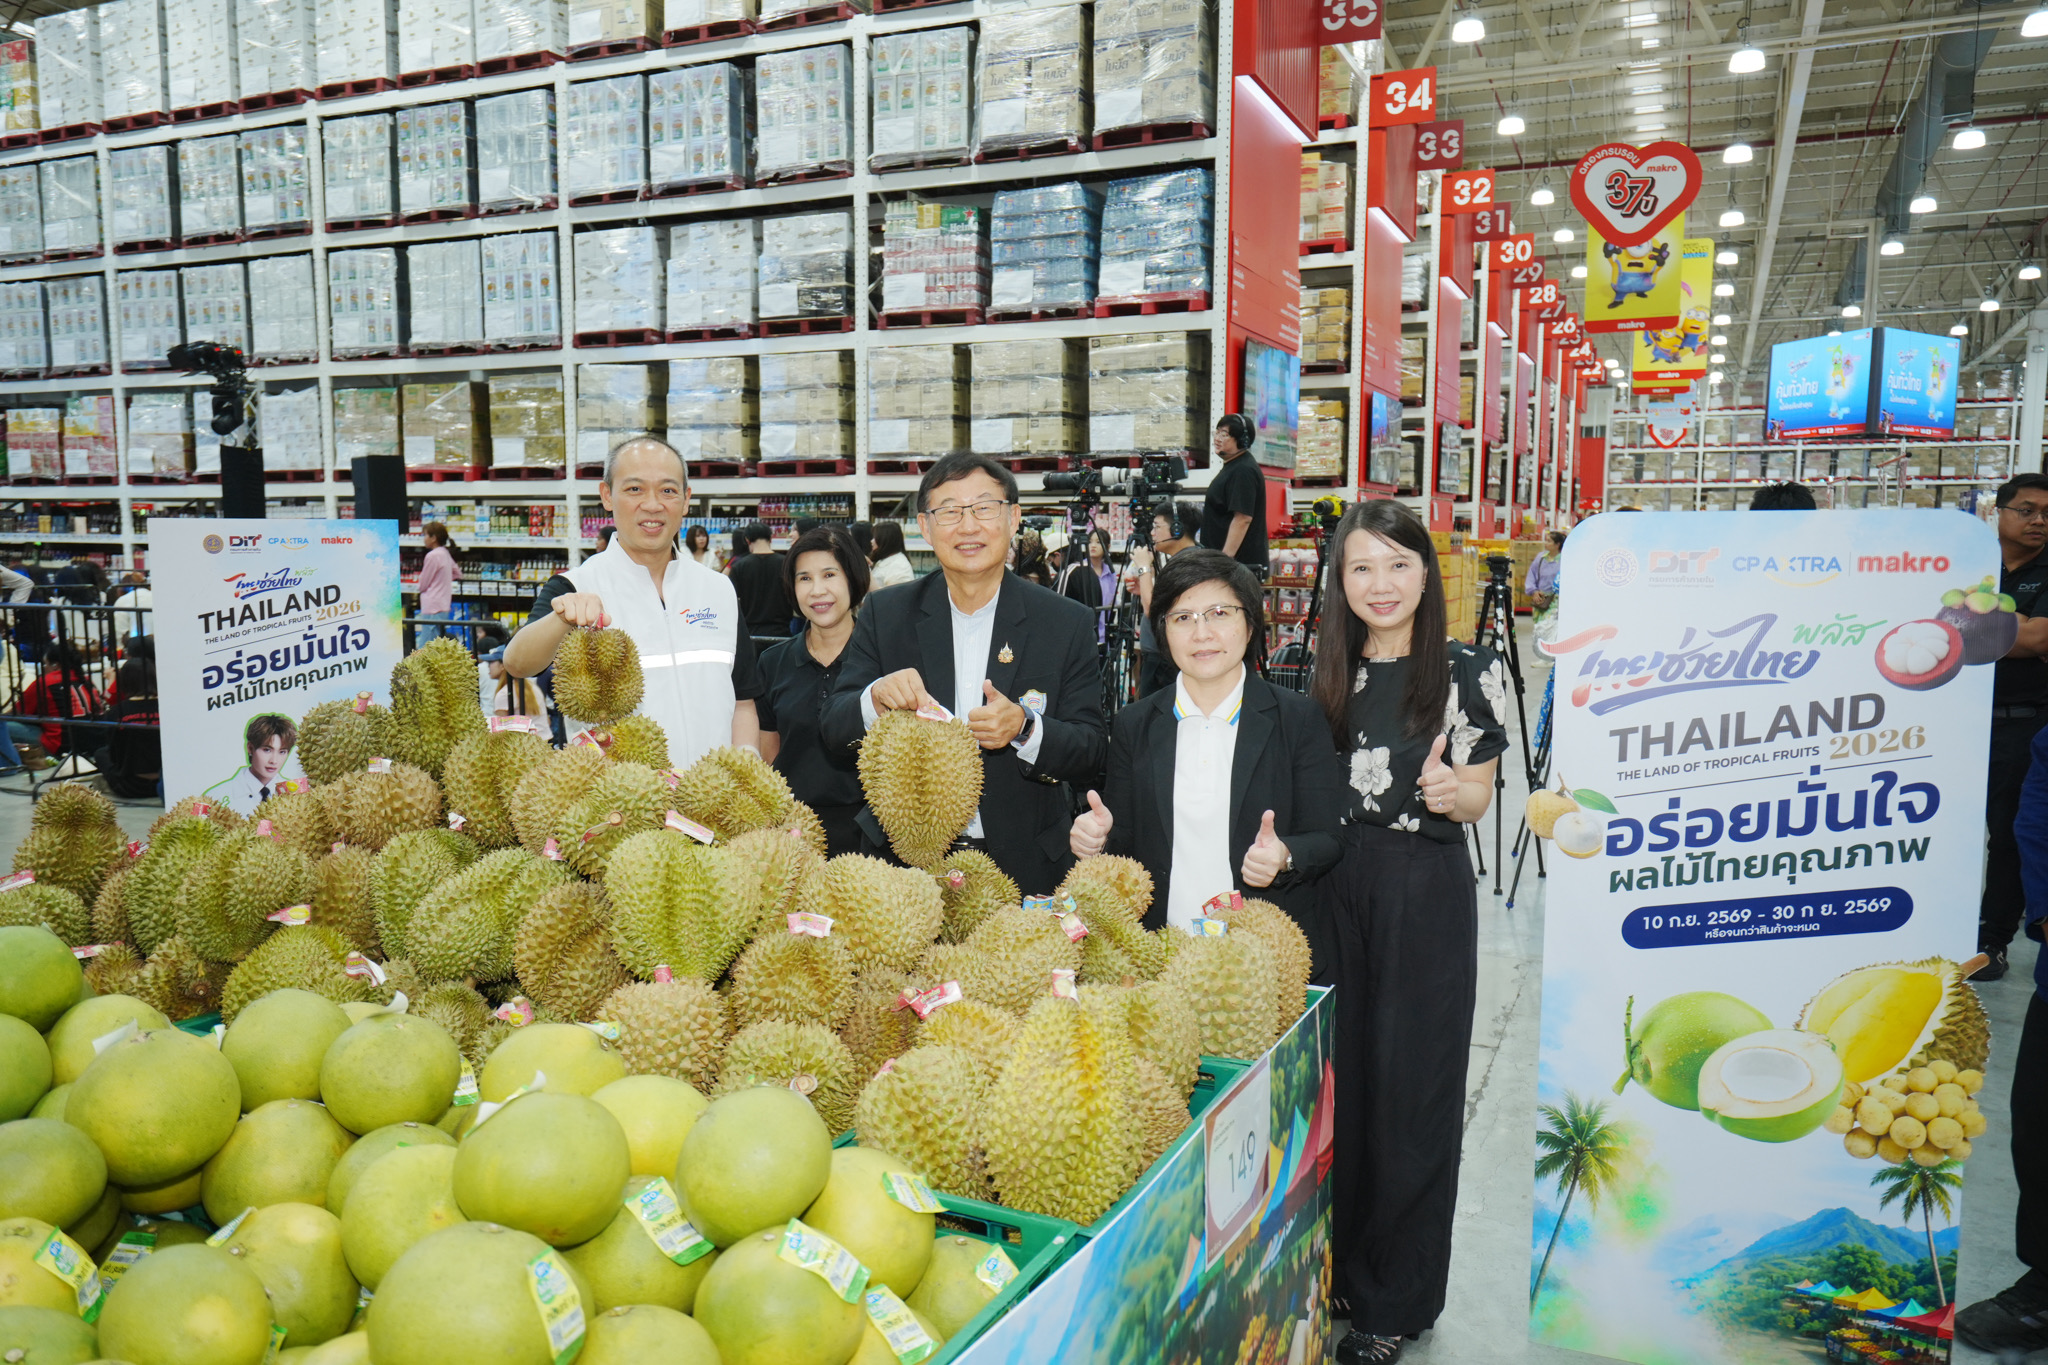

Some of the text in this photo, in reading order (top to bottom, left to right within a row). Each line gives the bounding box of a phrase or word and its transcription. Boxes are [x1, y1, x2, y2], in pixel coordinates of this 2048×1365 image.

[1322, 0, 1378, 31] 35
[1385, 77, 1433, 115] 34
[1417, 129, 1460, 161] 33
[1646, 164, 1678, 173] makro
[1453, 177, 1492, 206] 32
[1606, 170, 1654, 215] 37
[1475, 209, 1505, 234] 31
[1500, 239, 1532, 263] 30
[1513, 262, 1543, 283] 29
[1529, 284, 1557, 304] 28
[1617, 321, 1645, 329] makro
[321, 536, 353, 545] makro
[1732, 556, 1842, 572] CP AXTRA
[1857, 551, 1950, 573] makro
[197, 584, 341, 634] THAILAND
[315, 600, 361, 622] 2026
[205, 614, 312, 645] THE LAND OF TROPICAL FRUITS
[202, 624, 371, 690] อร่อยมั่นใจ
[207, 656, 368, 711] ผลไม้ไทยคุณภาพ
[1608, 692, 1886, 764] THAILAND
[1829, 725, 1926, 760] 2026
[1616, 745, 1820, 782] THE LAND OF TROPICAL FRUITS
[1605, 764, 1941, 857] อร่อยมั่นใจ
[1609, 836, 1931, 893] ผลไม้ไทยคุณภาพ
[1642, 915, 1663, 930] 10
[1669, 913, 1701, 928] ก.ย.
[1707, 908, 1752, 925] 2569
[1771, 905, 1795, 920] 30
[1844, 897, 1892, 914] 2569
[1704, 922, 1820, 939] หรือจนกว่าสินค้าจะหมด
[1228, 1131, 1256, 1193] 149
